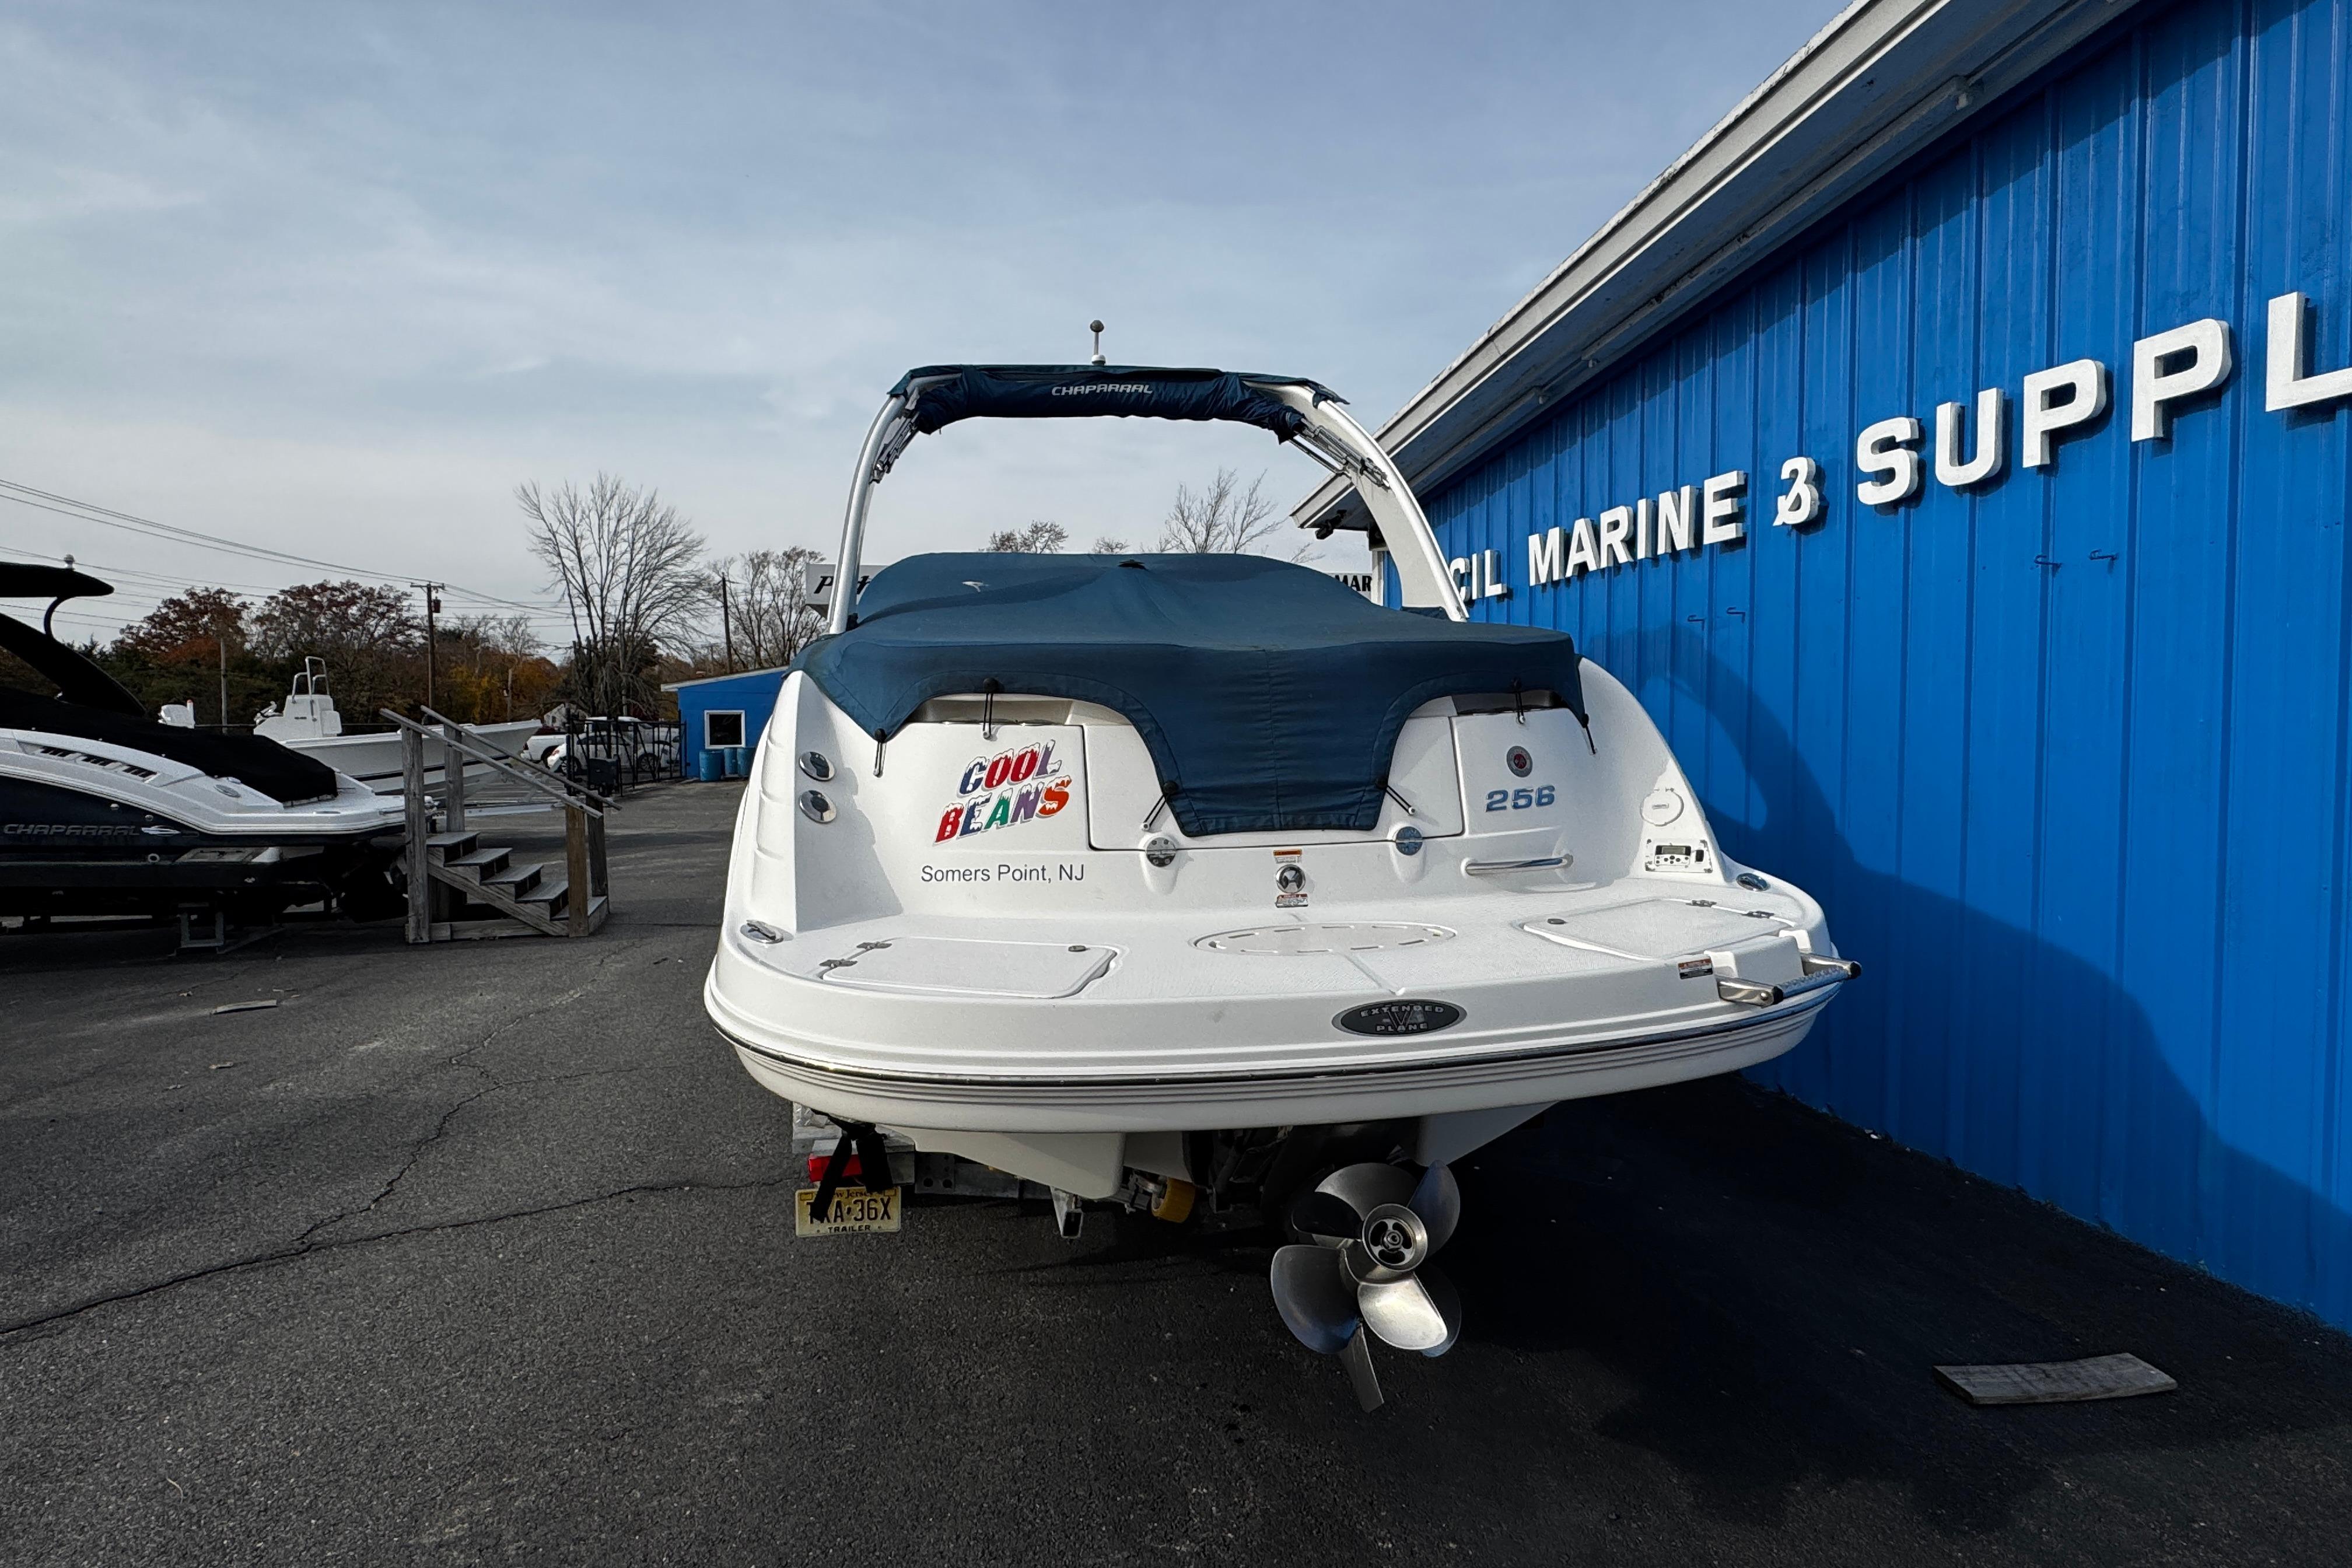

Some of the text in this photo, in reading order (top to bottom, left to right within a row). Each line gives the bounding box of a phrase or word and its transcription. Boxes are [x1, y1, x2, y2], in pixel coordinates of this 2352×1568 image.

[1051, 384, 1153, 396] CHAPARRAL
[1528, 470, 1745, 586] MARINE
[1857, 292, 2352, 505] SUPPL
[957, 739, 1062, 797] COOL
[1485, 785, 1555, 812] 256
[933, 775, 1072, 846] BEANS
[4, 824, 140, 835] CHAPARRAL
[921, 864, 1084, 883] Somers Point, NJ
[1360, 1005, 1444, 1017] EXTENDED
[1376, 1023, 1428, 1032] PLANE
[828, 1225, 871, 1234] TRAILER
